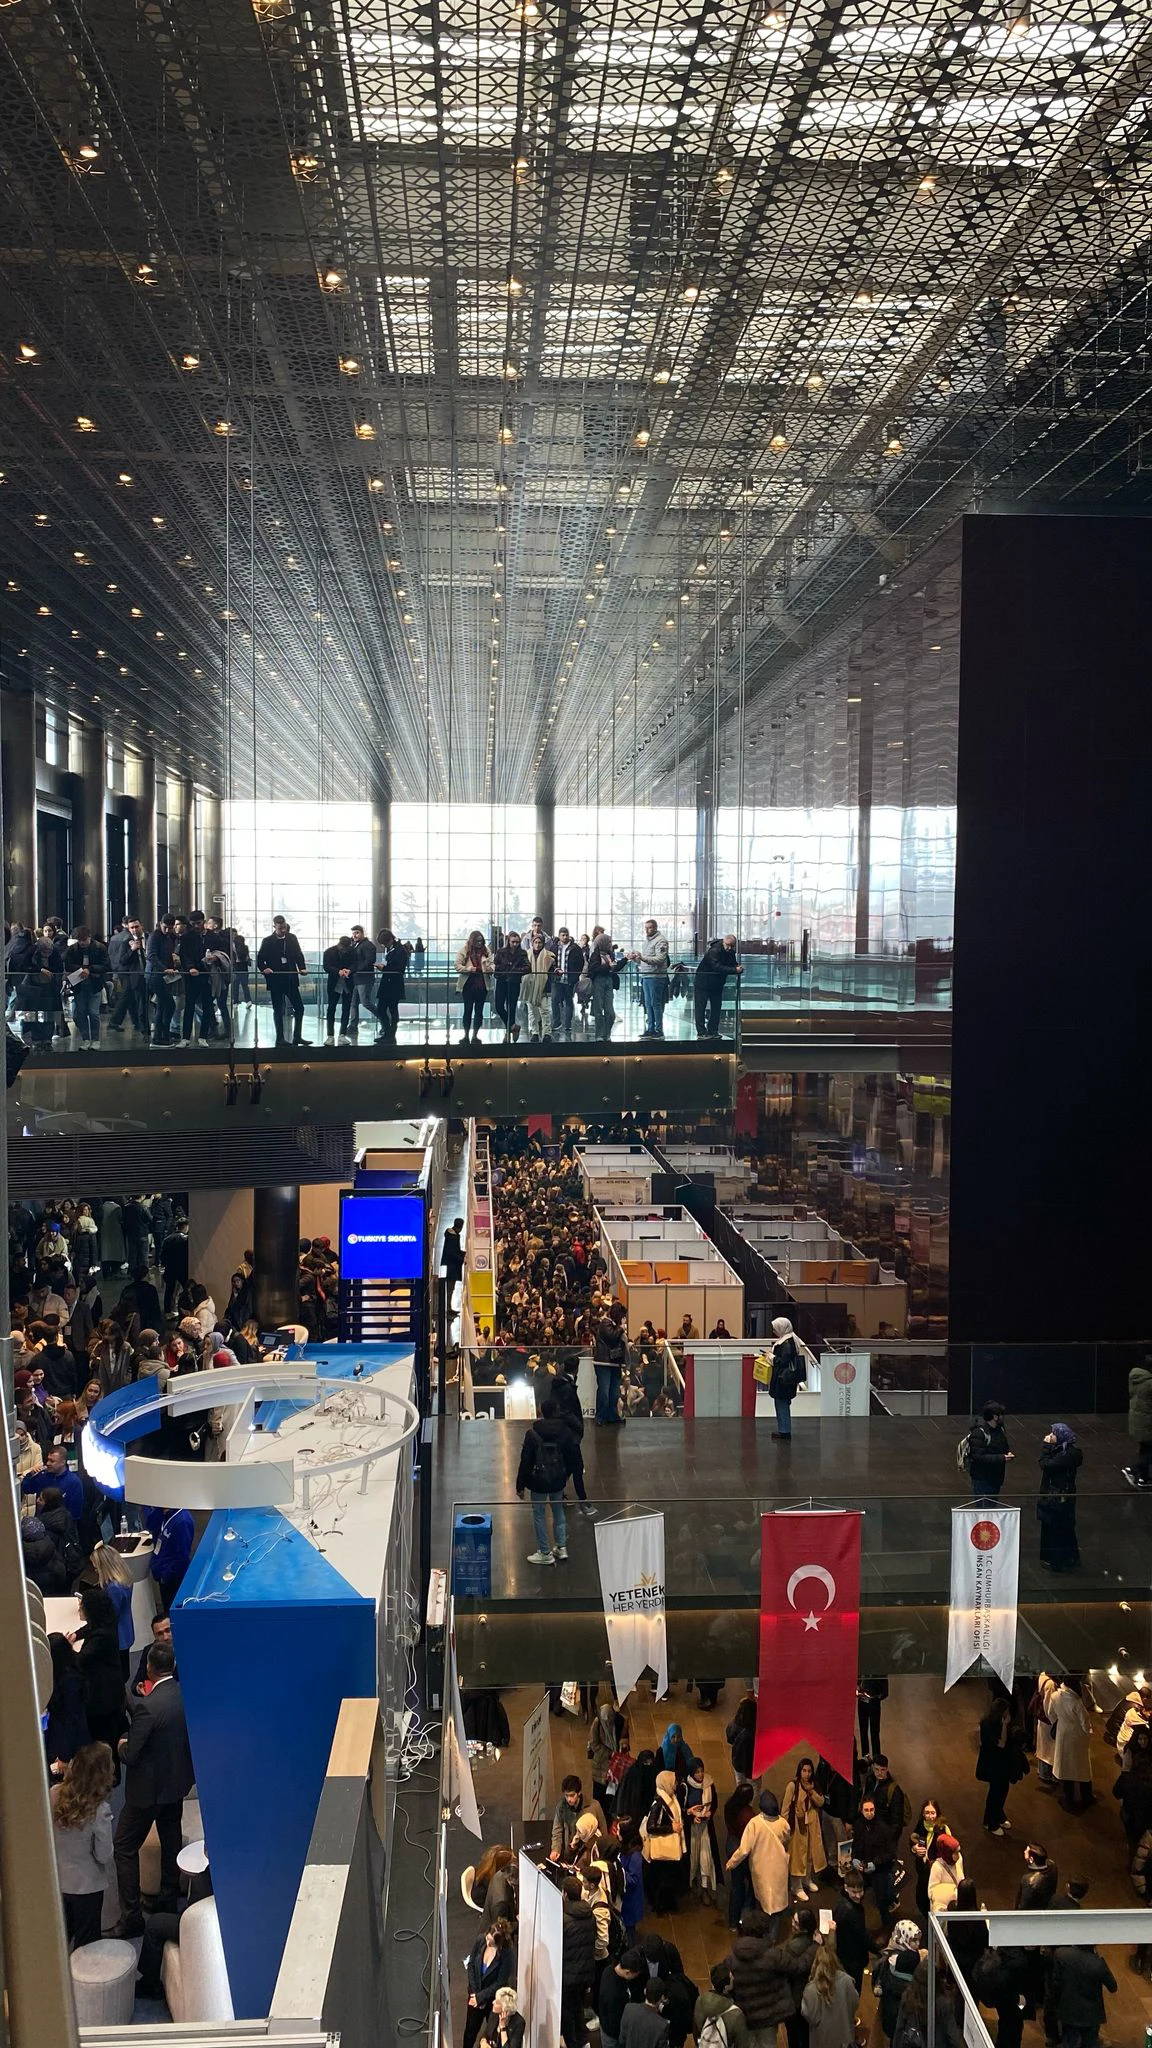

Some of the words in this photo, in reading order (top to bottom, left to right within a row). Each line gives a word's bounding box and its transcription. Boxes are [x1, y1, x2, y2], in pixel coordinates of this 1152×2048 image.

[609, 1585, 665, 1603] YETENEK
[613, 1601, 634, 1613] HER
[975, 1580, 983, 1628] KAYNAKLARI
